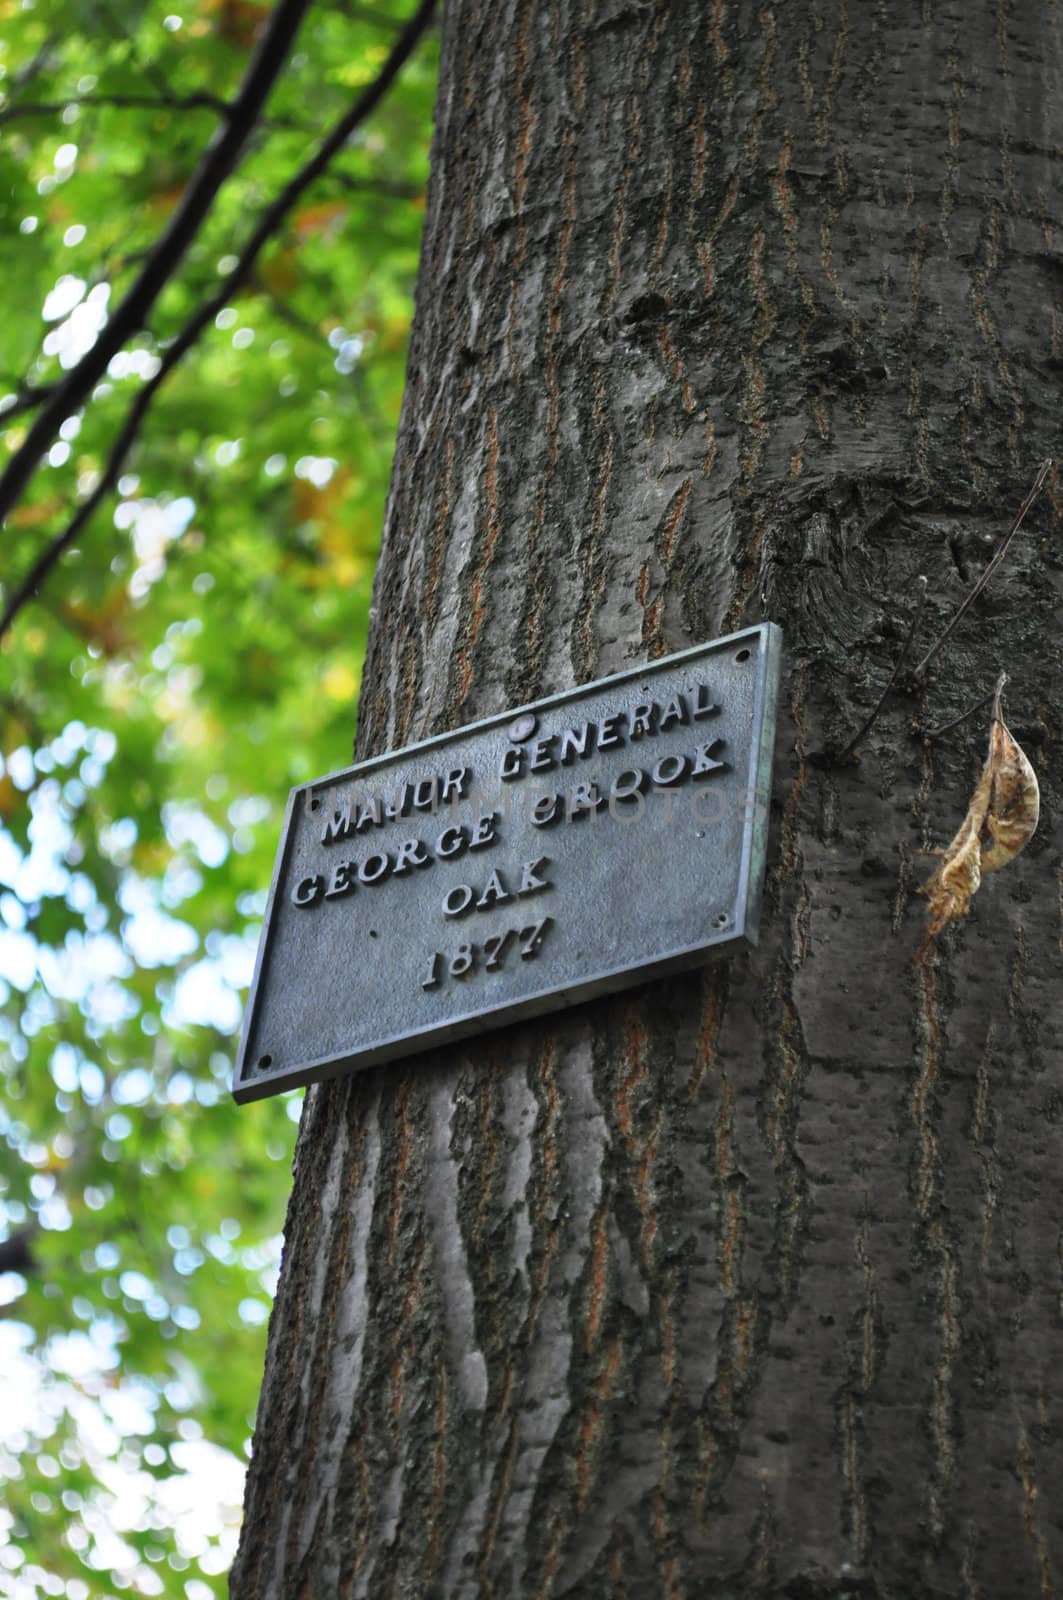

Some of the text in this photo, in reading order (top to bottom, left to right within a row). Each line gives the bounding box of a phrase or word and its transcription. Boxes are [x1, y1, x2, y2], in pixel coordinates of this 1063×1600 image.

[291, 738, 727, 906] GEORGE CROOK
[320, 683, 720, 845] MAJOR GENERAL
[441, 856, 549, 918] OAK
[421, 916, 554, 991] 1877
